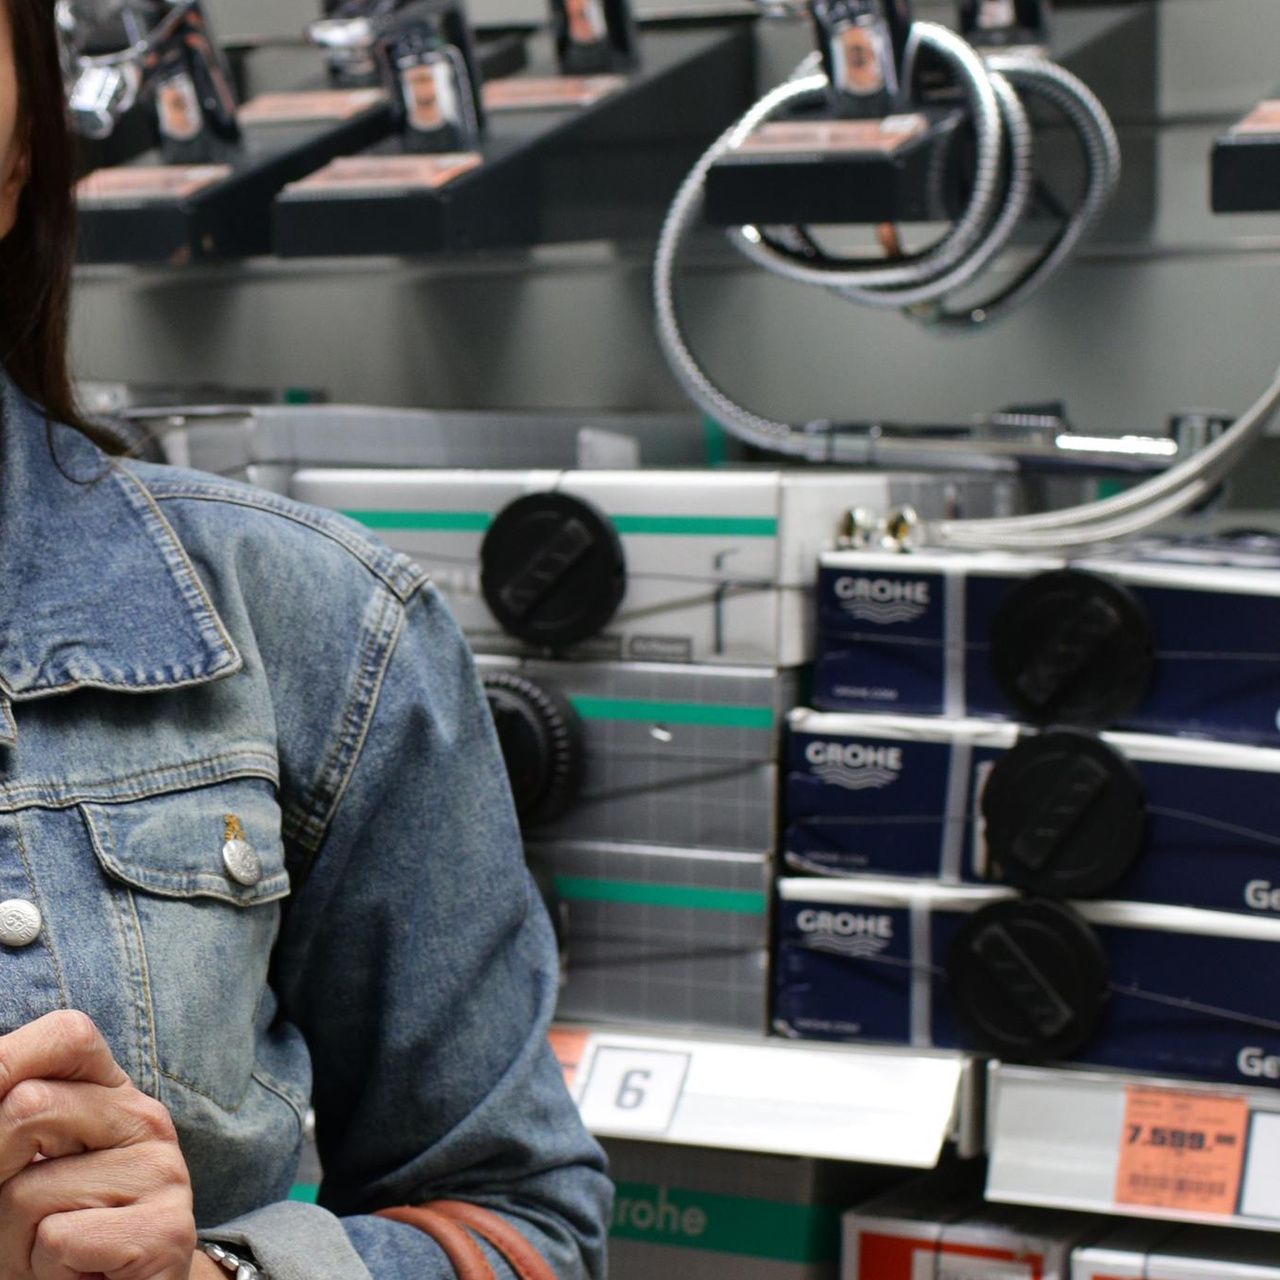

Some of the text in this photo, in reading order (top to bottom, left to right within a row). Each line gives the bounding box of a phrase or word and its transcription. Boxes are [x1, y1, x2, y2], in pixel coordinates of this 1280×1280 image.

[834, 576, 930, 604] GROHE
[805, 741, 903, 770] GROHE
[796, 909, 894, 938] GROHE
[614, 1068, 651, 1110] 6
[609, 1186, 708, 1237] rohe
